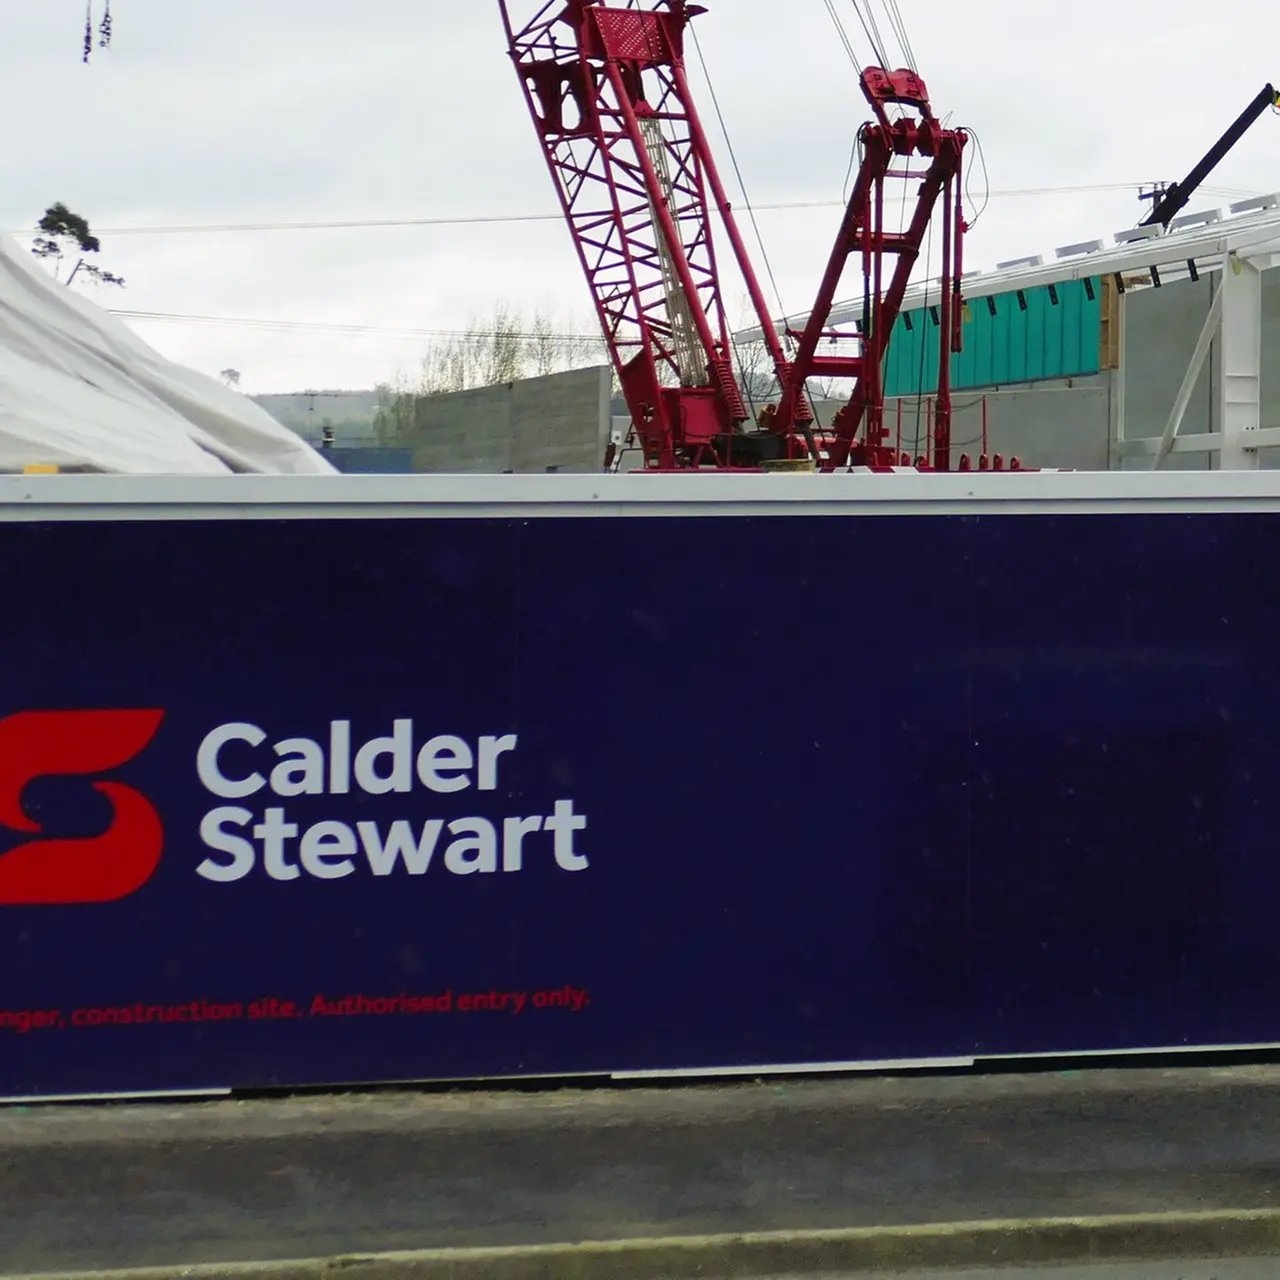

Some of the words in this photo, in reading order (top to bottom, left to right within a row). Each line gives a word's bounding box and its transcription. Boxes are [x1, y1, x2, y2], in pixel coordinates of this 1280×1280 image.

[196, 719, 518, 798] Calder
[196, 800, 589, 882] Stewart
[71, 1000, 243, 1025] construction
[247, 996, 302, 1019] site.
[309, 990, 451, 1017] Authorised
[456, 990, 527, 1015] entry
[531, 984, 591, 1012] only.
